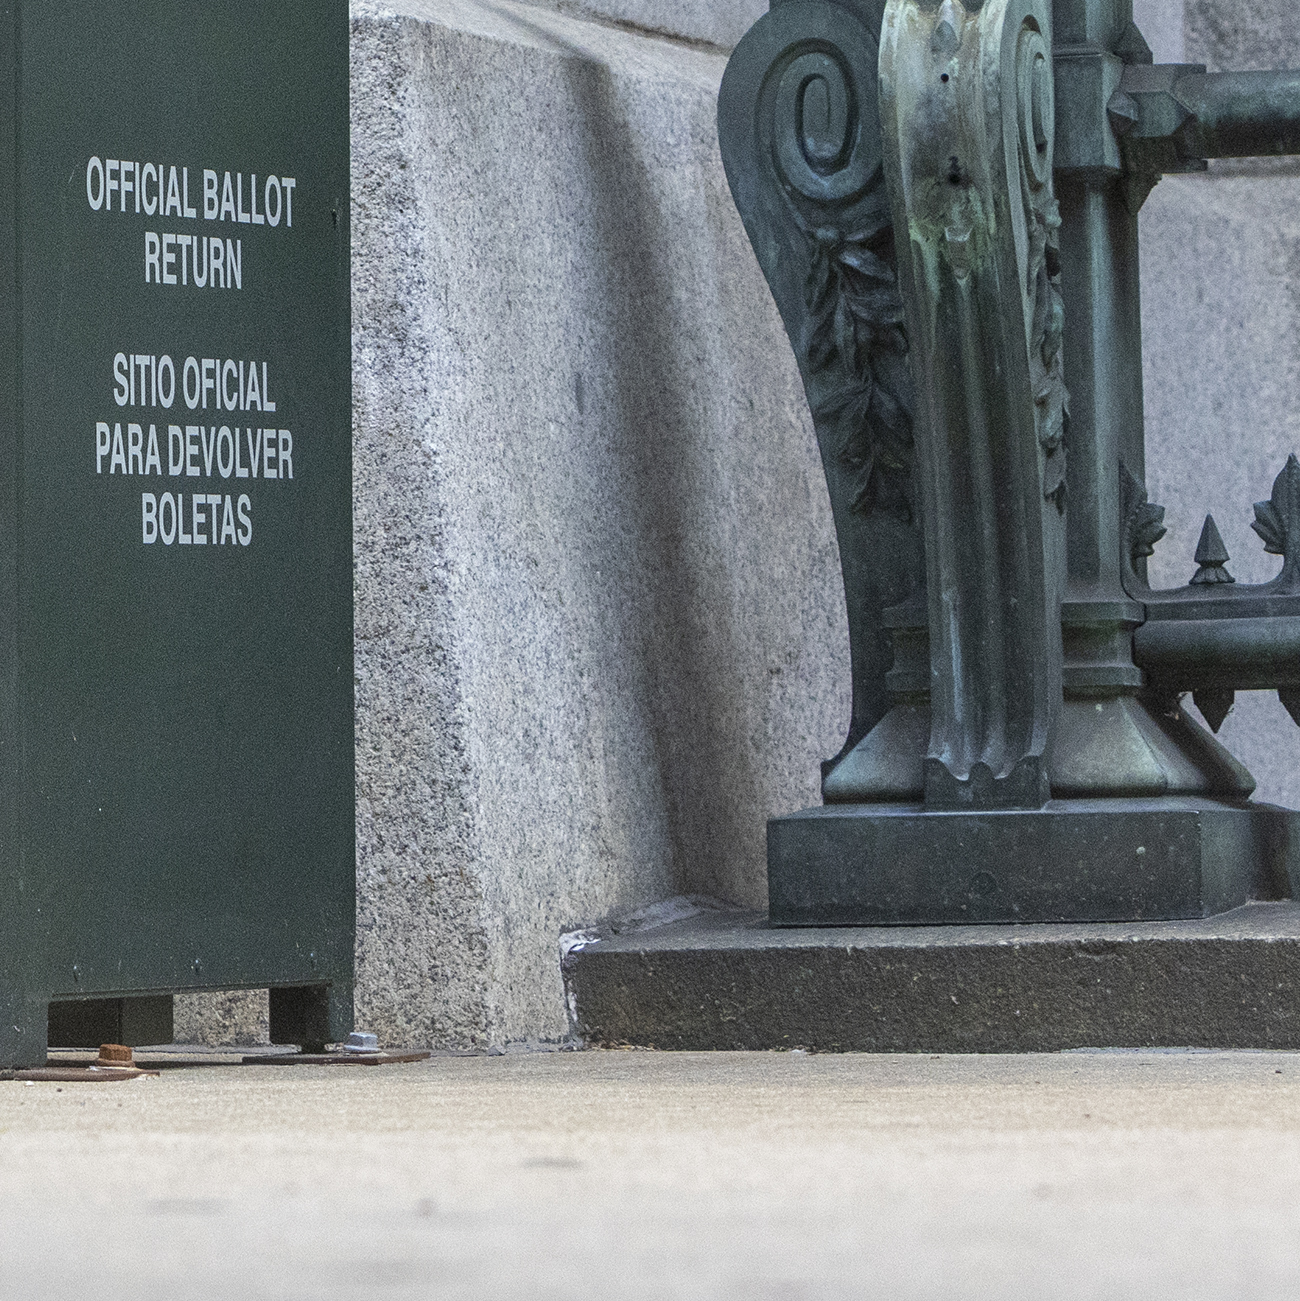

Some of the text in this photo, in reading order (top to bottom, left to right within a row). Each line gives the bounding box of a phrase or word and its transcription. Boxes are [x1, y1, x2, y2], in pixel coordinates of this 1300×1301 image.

[86, 155, 296, 227] OFFICIAL BALLOT
[144, 231, 242, 290] RETURN
[113, 352, 276, 412] SITIO OFICIAL
[96, 422, 293, 479] PARA DEVOLVER
[142, 491, 252, 547] BOLETAS
